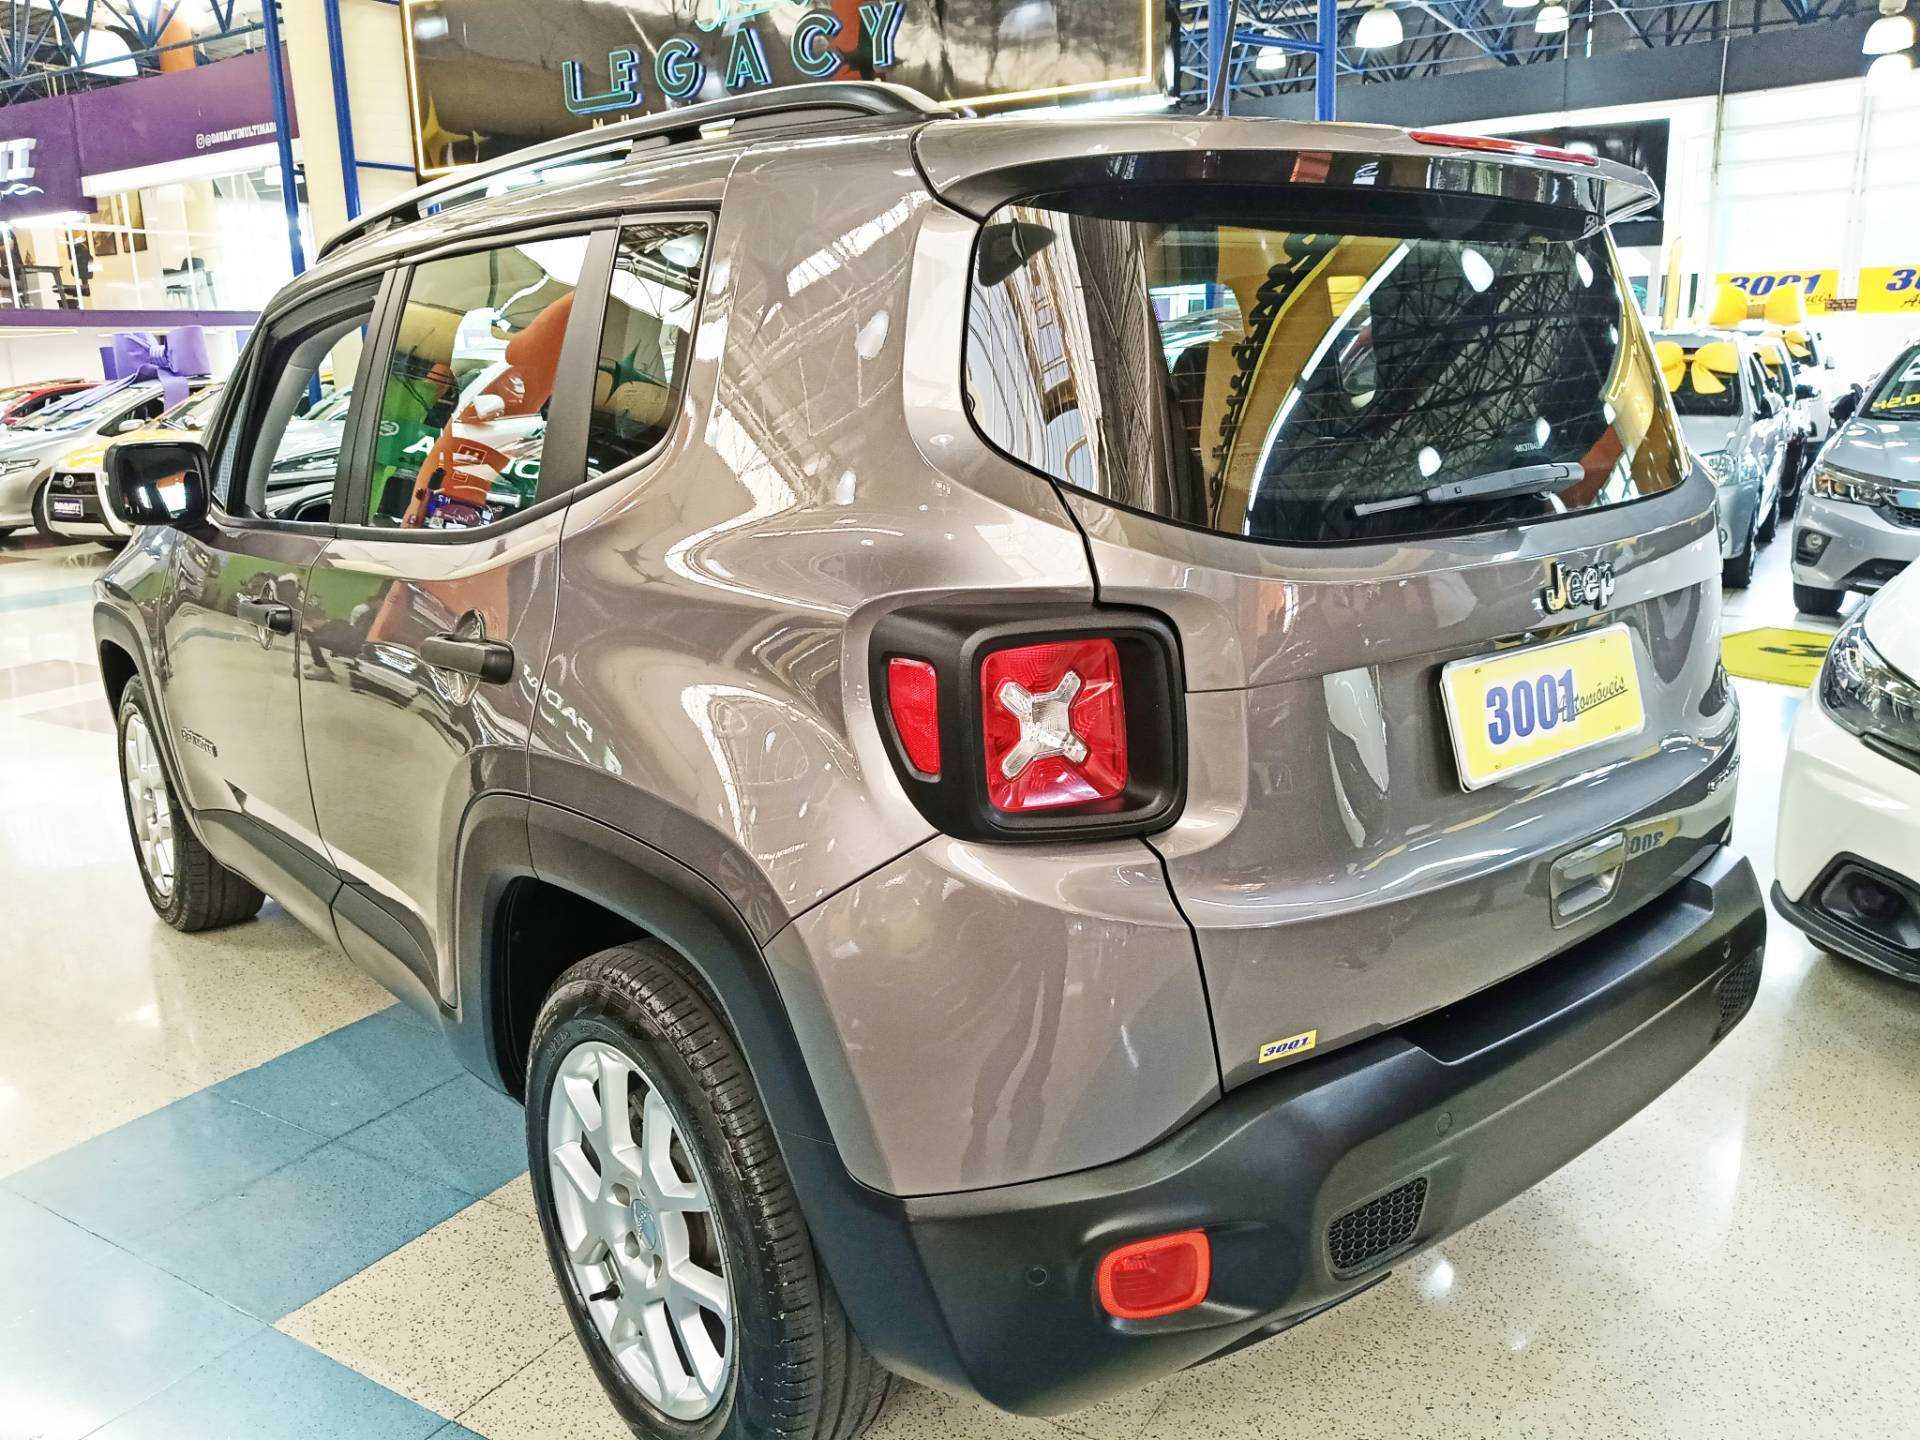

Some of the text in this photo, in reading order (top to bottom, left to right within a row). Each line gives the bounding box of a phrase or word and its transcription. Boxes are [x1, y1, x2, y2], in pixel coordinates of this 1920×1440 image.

[562, 1, 904, 114] LEGACY
[1542, 561, 1615, 614] Jeep
[1486, 668, 1576, 745] 3001
[1263, 1036, 1310, 1057] 3001
